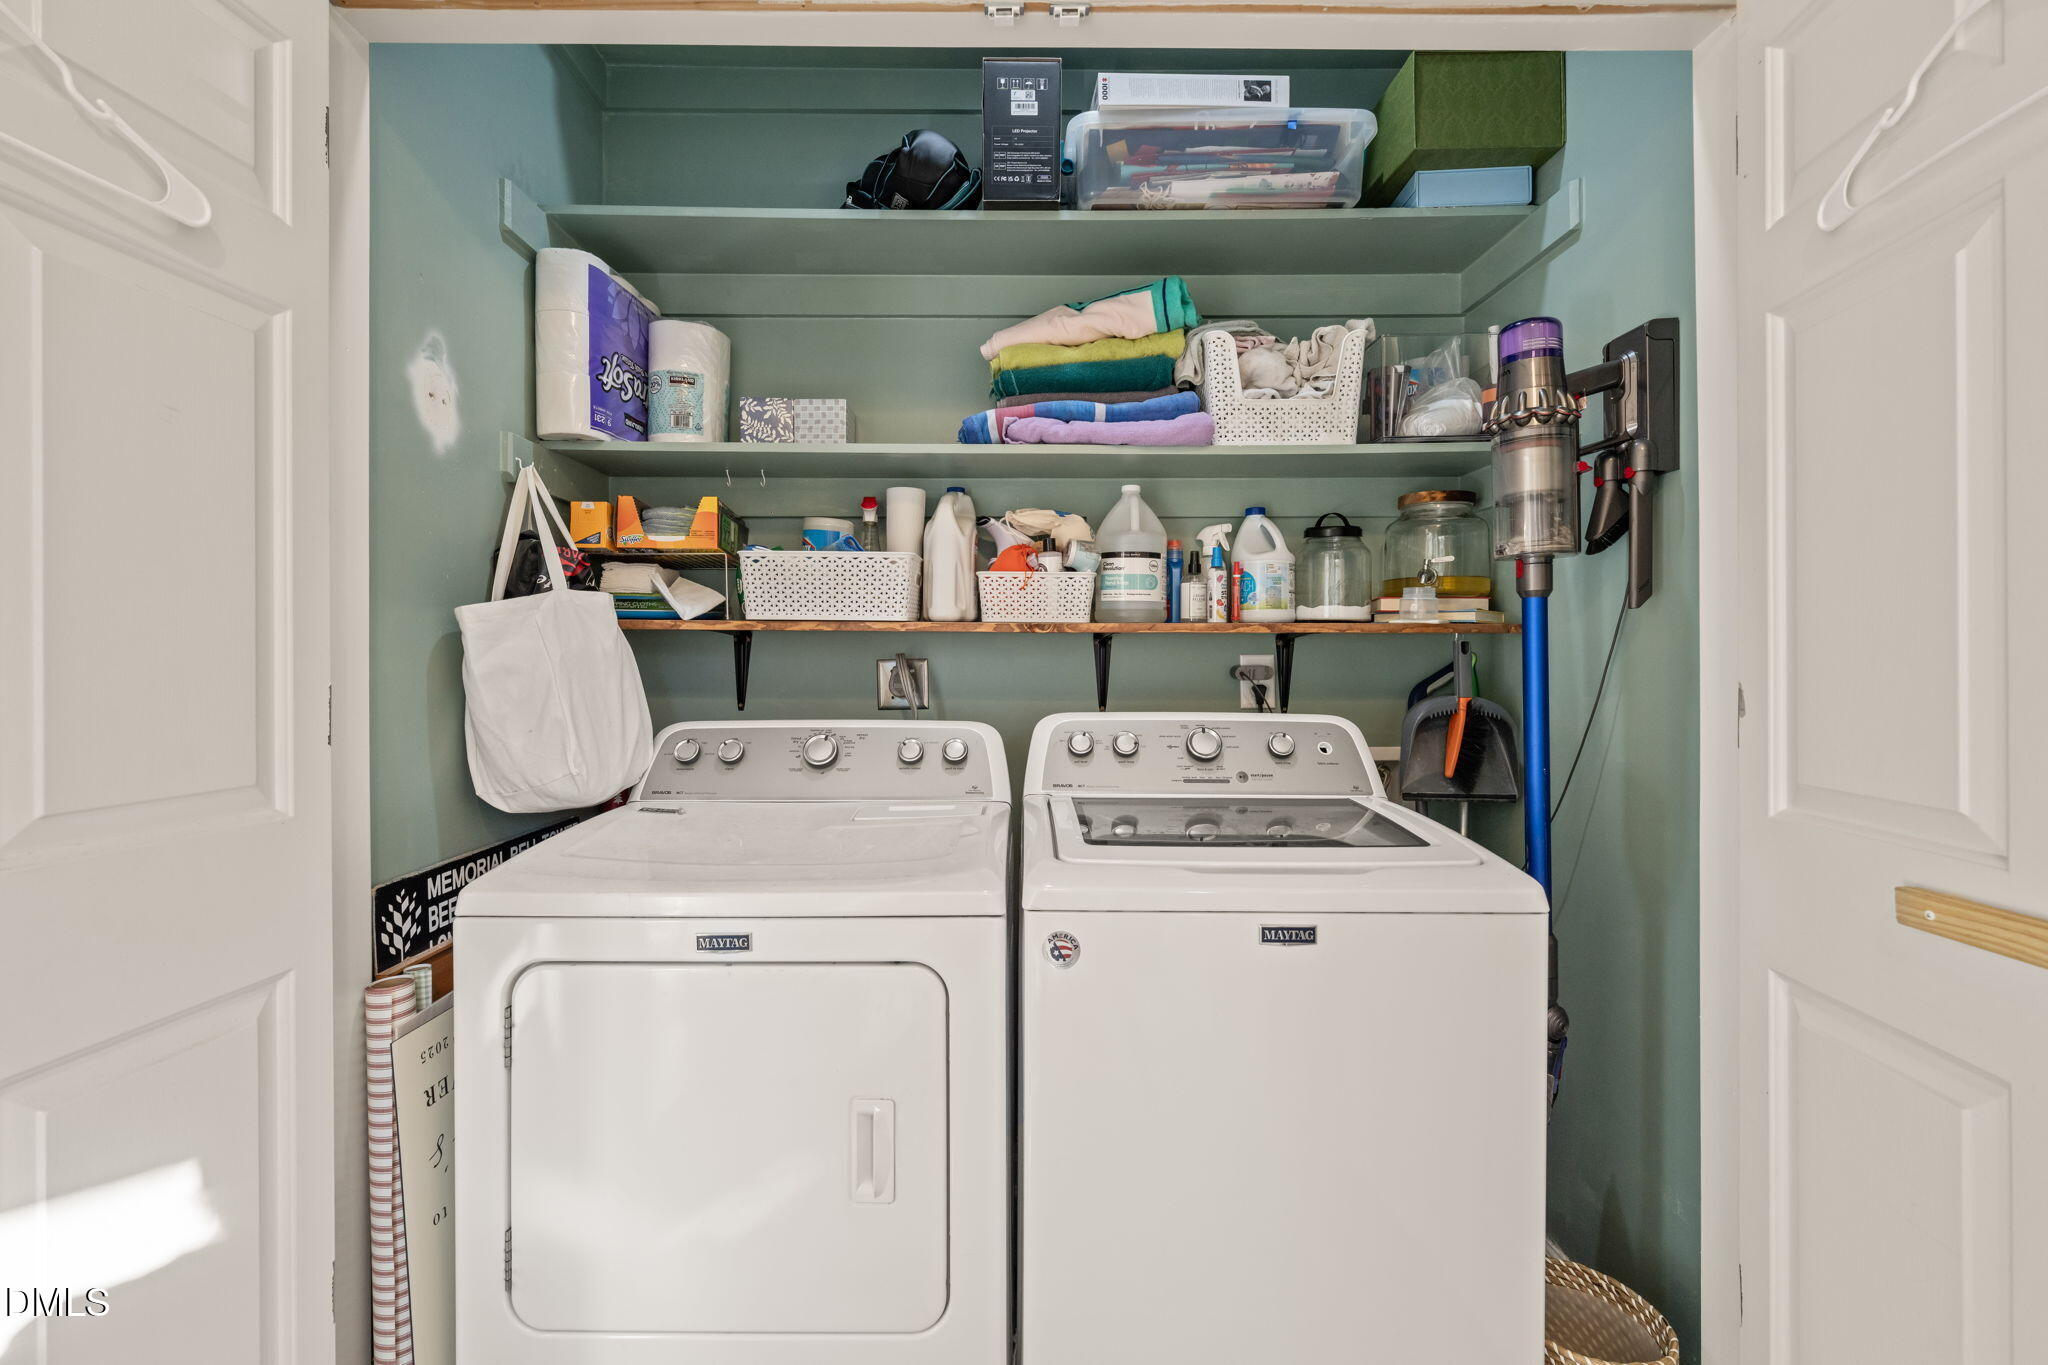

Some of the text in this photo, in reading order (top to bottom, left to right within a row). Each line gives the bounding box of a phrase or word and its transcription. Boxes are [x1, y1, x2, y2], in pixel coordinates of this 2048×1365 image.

[594, 413, 612, 427] 231 9
[620, 535, 644, 544] Swiffer
[427, 850, 504, 900] MEMORIAL
[698, 937, 748, 949] MAYTAG
[1047, 933, 1079, 951] AMERICA
[1263, 929, 1315, 941] MAYTAG
[420, 1036, 449, 1065] 2025
[424, 1075, 455, 1107] ER
